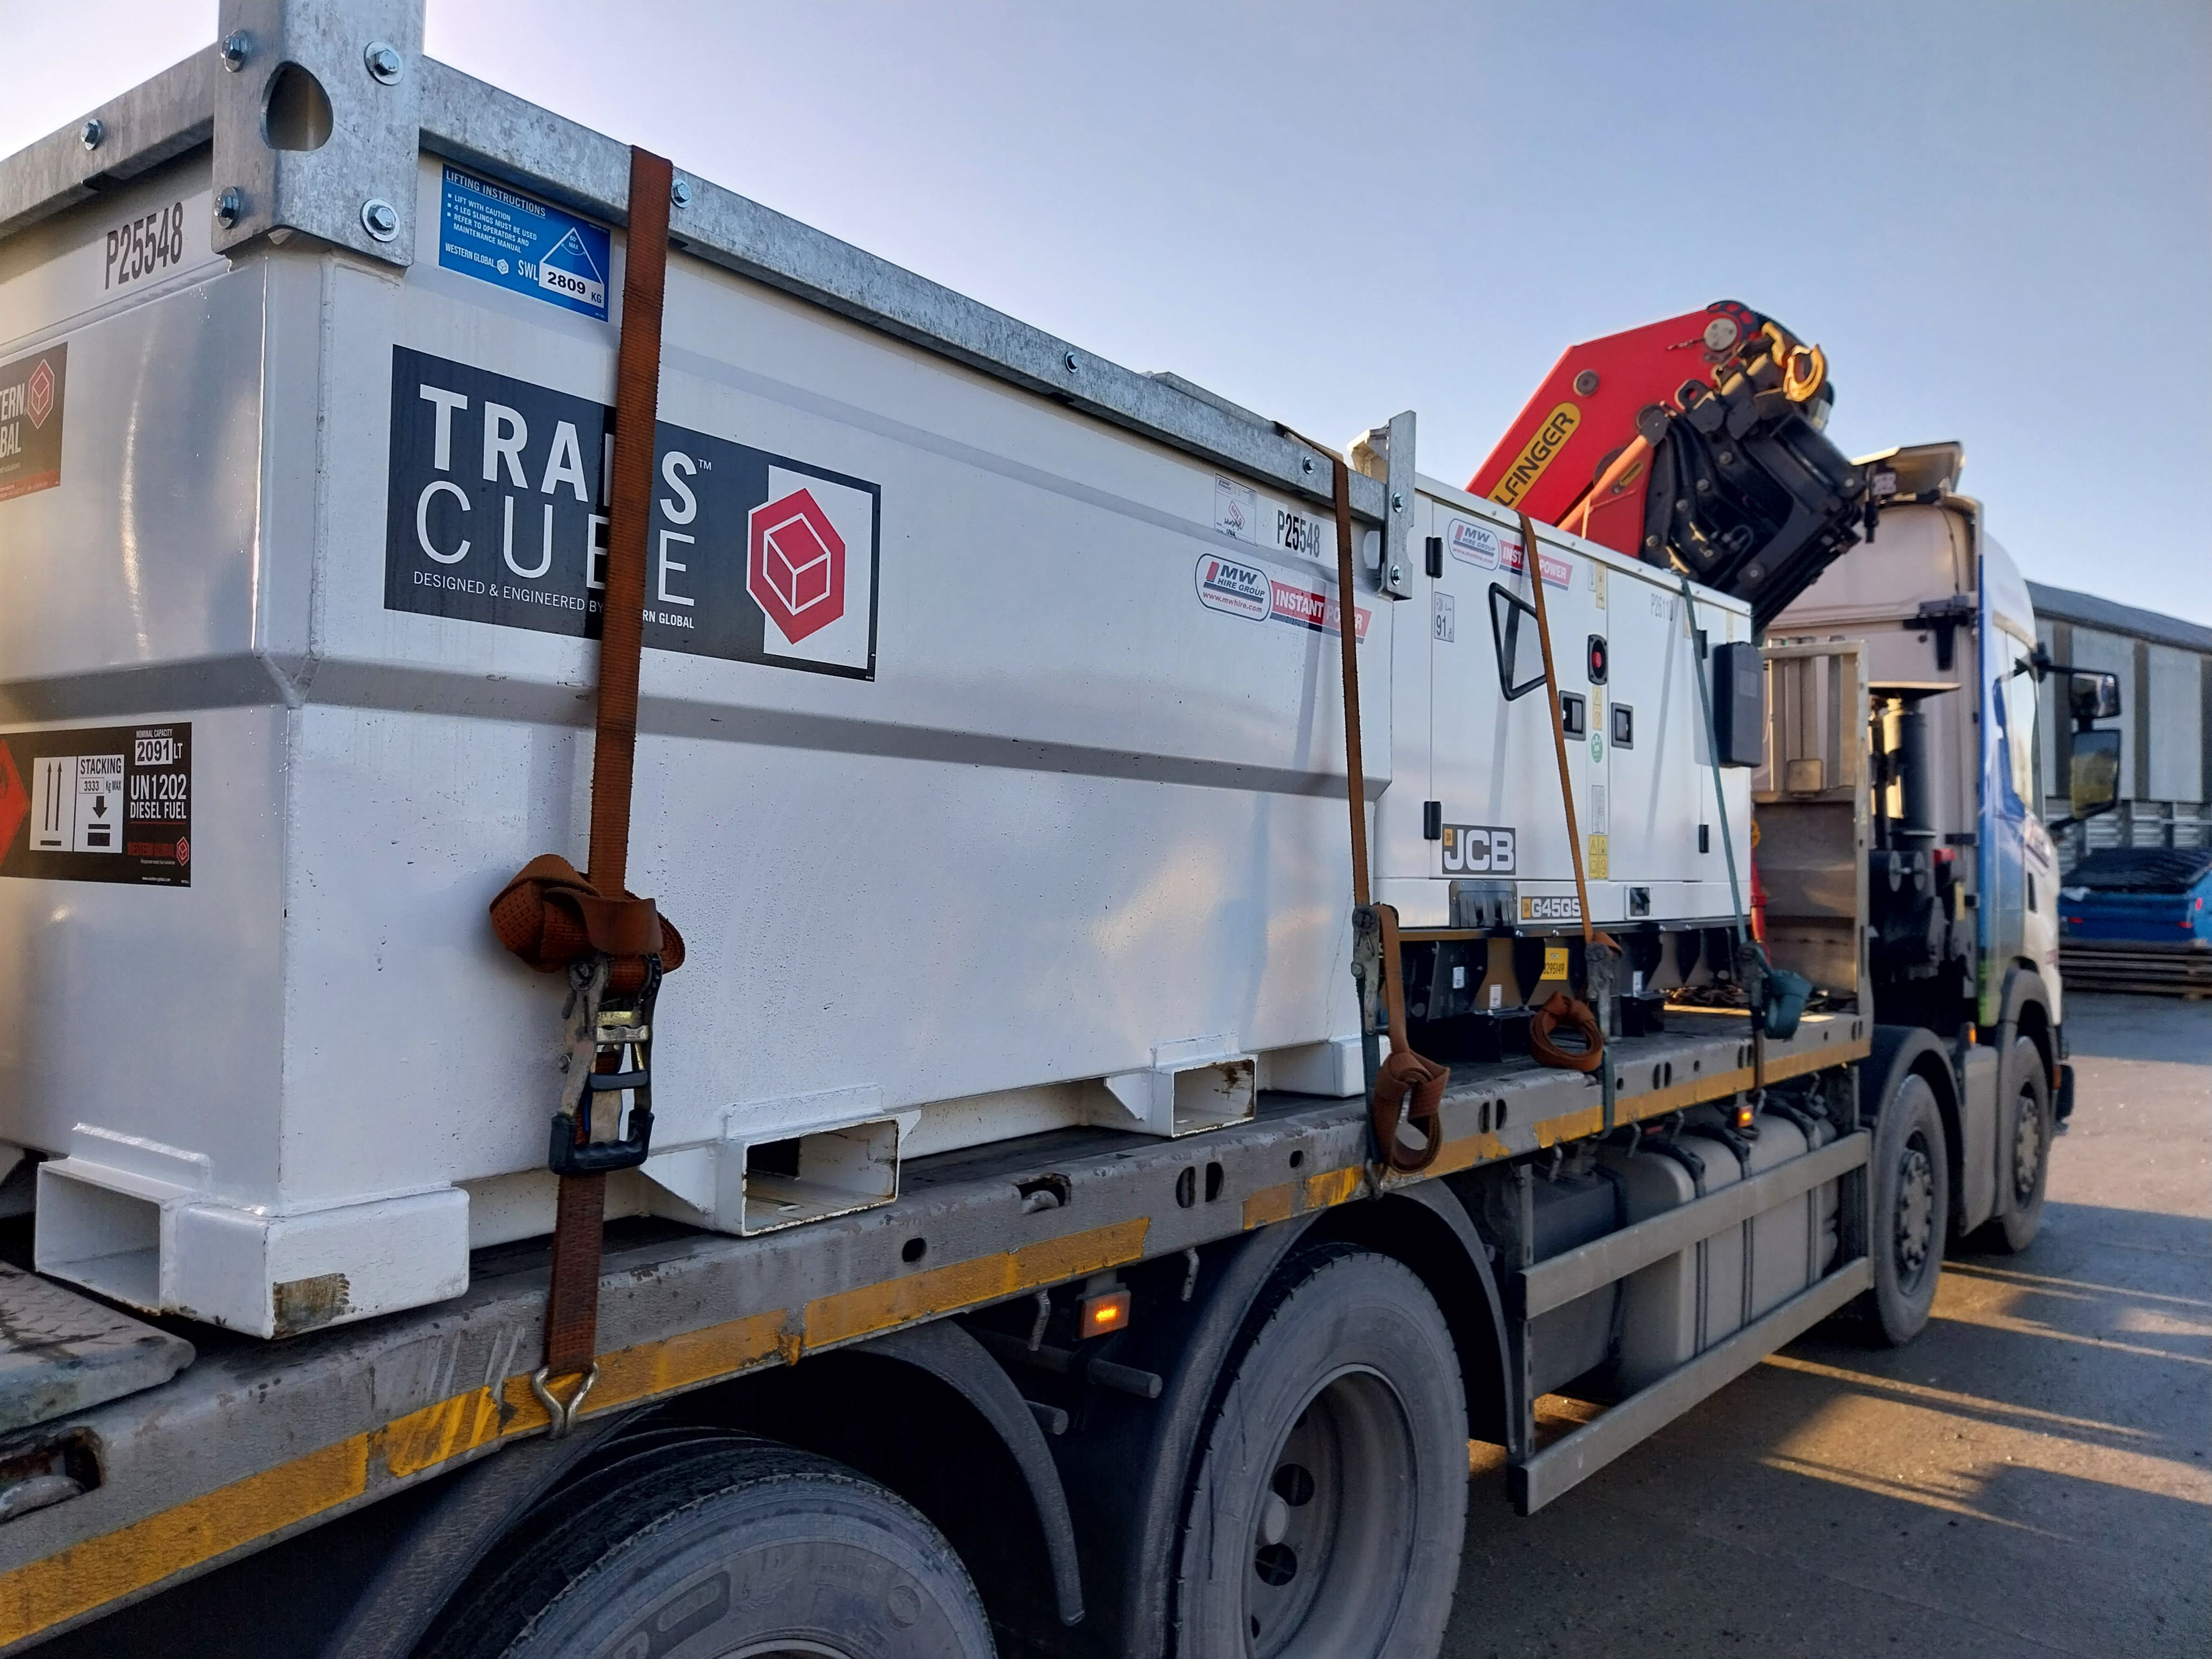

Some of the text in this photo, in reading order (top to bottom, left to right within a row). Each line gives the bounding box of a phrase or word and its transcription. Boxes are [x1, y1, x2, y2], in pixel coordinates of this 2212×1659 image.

[446, 170, 546, 216] LIFTING INSTRUCTIONS
[454, 195, 511, 221] LIFT WITH CAUTION
[454, 213, 529, 247] REFER TO OPERATORS AND
[460, 206, 471, 216] LEG
[472, 211, 493, 224] SLINGS
[495, 220, 511, 231] MUST
[513, 226, 520, 235] BE
[522, 229, 537, 240] USED
[105, 202, 183, 290] P25548
[453, 223, 522, 253] MAINTENANCE MANUAL
[445, 243, 495, 267] WESTERN GLOBAL
[518, 260, 538, 281] SWL
[548, 272, 602, 304] 2809 KG
[420, 384, 697, 525] TRAS
[1277, 510, 1320, 558] P25548
[1465, 528, 1490, 543] MW
[1477, 542, 1495, 551] GROUP
[1220, 565, 1257, 585] MW
[1540, 559, 1567, 580] POWER
[1218, 578, 1265, 596] HIRE GROUP
[414, 571, 485, 595] DESIGNED
[489, 584, 498, 597] &
[503, 586, 586, 610] ENGINEERED
[659, 613, 695, 629] GLOBAL
[1203, 592, 1262, 613] www.mwhire.com
[1276, 589, 1362, 629] INSTANT POR
[1437, 614, 1446, 637] 91
[154, 729, 172, 737] CAPACITY
[137, 740, 183, 762] 2091 LT
[81, 758, 121, 775] STACKING
[84, 781, 99, 791] 3333
[112, 781, 121, 790] MAX
[131, 774, 187, 800] UN1202
[130, 802, 187, 819] DIESEL FUEL
[1444, 829, 1514, 871] JCB
